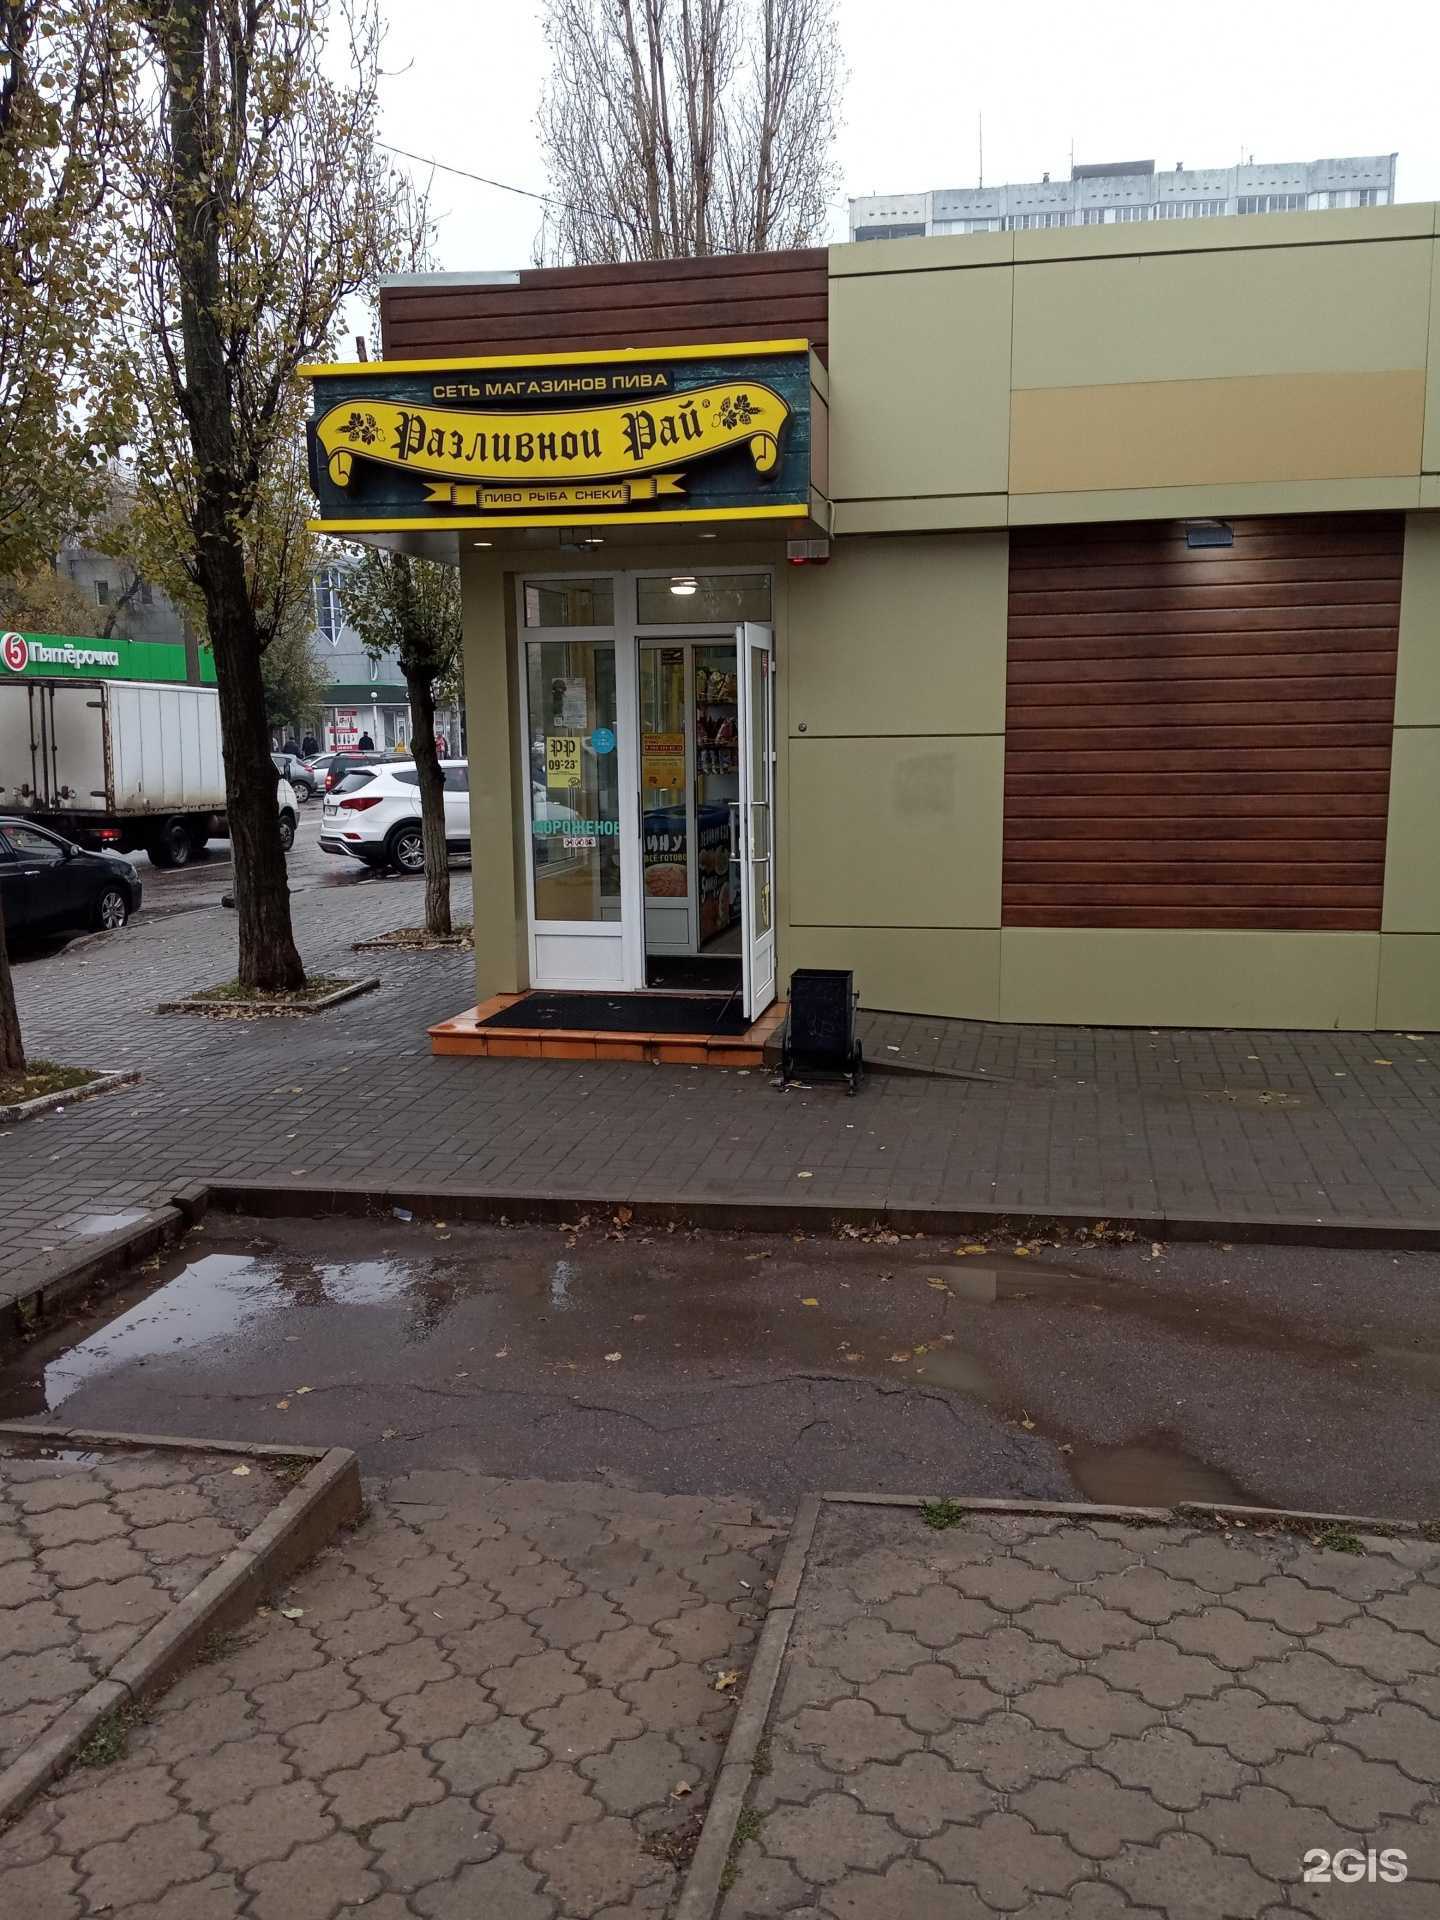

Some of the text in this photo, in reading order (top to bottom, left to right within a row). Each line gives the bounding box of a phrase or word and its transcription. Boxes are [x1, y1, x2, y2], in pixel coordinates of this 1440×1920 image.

[433, 372, 668, 398] СЕТЬ МАГАЗИНОВ ПИВА
[621, 400, 704, 460] Рай
[484, 489, 622, 503] ПИВО РЫБА СНЕКИ
[28, 642, 118, 668] Пятёрочка
[643, 834, 687, 852] ИНУ
